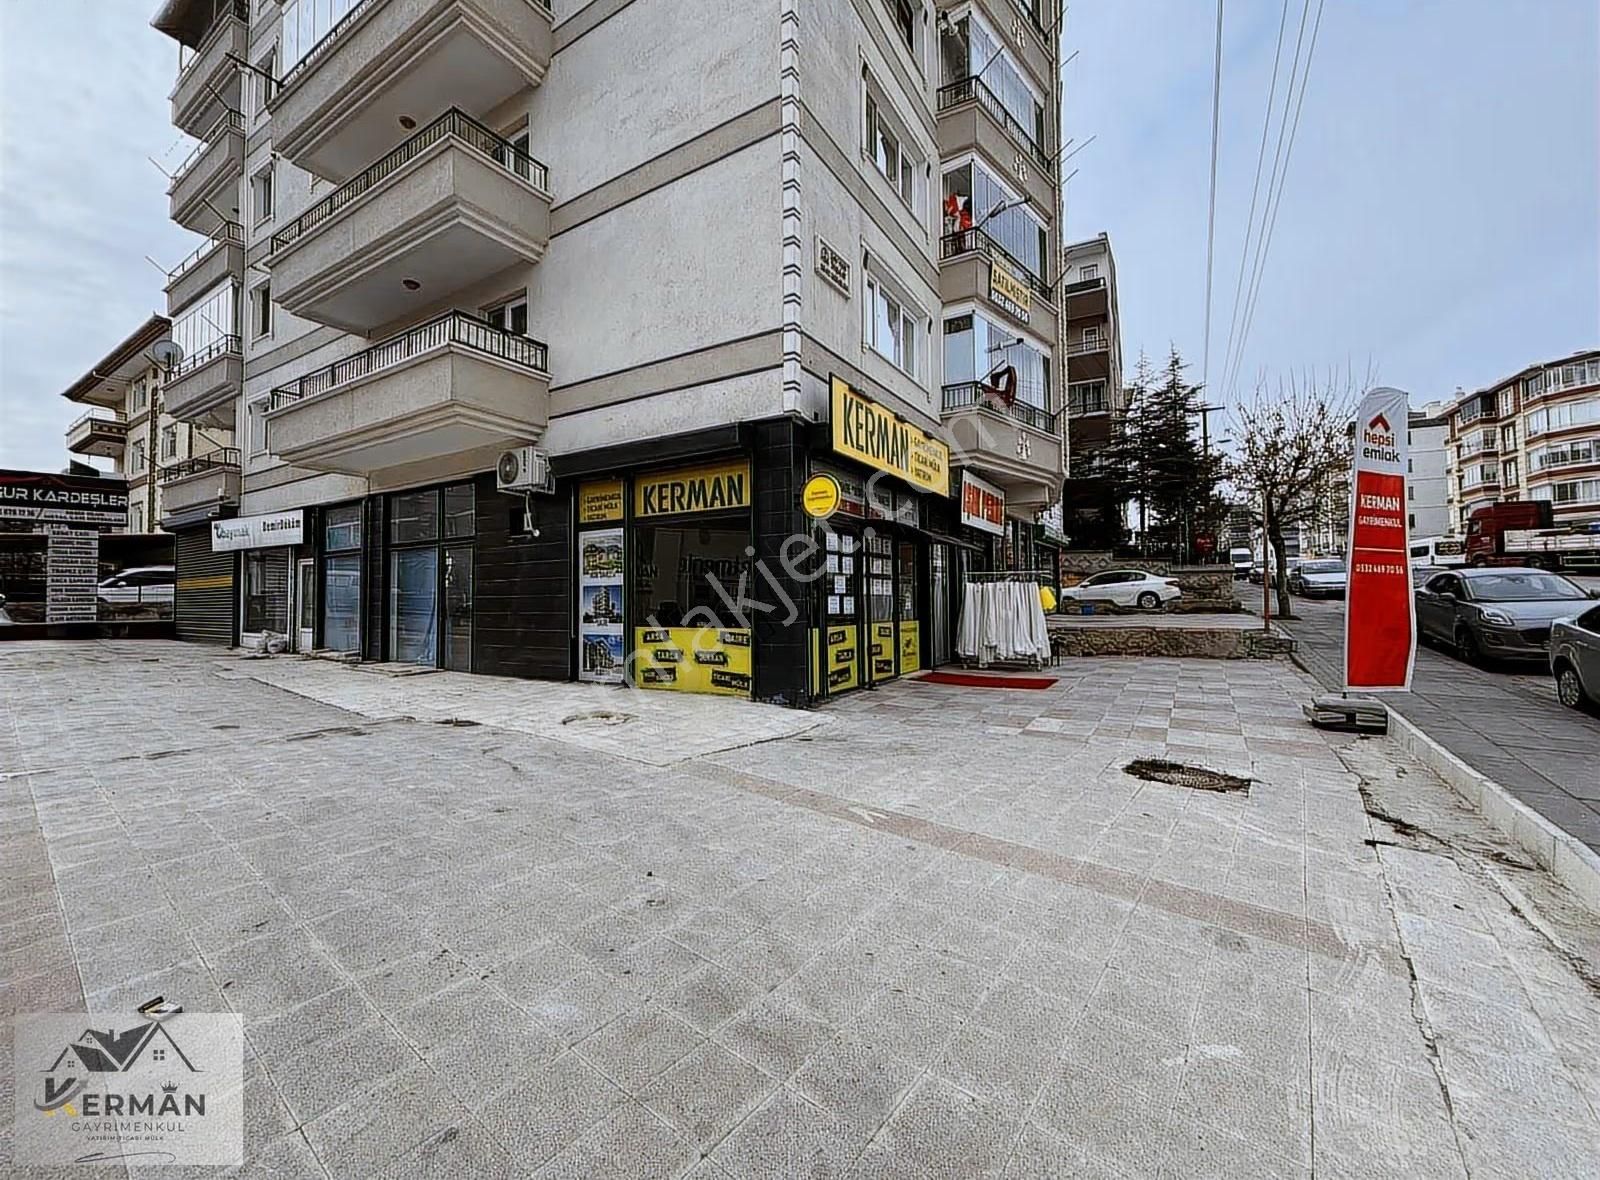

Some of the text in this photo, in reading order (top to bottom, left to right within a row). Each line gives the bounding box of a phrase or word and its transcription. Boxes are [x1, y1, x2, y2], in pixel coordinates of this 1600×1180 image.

[843, 393, 909, 473] KERMAN
[1364, 430, 1395, 448] hepsi
[1363, 447, 1400, 463] emlak
[33, 488, 128, 507] KARDEŞLER
[643, 473, 744, 515] KERMAN
[1360, 494, 1400, 511] KERMAN
